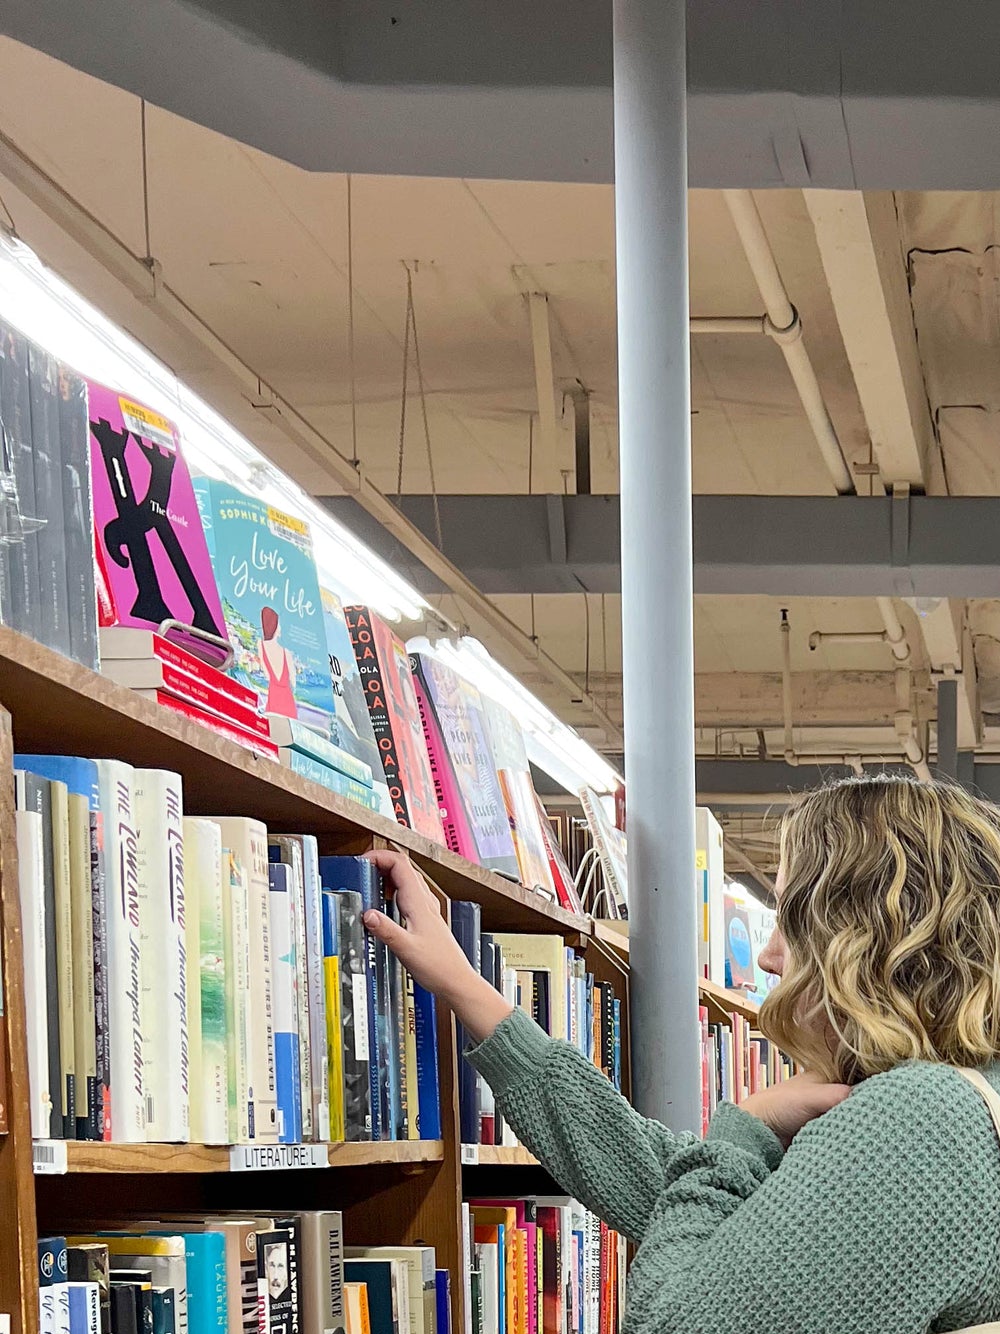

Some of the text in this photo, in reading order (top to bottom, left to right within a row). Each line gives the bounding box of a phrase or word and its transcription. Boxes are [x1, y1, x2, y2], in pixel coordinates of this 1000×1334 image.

[150, 500, 166, 516] The
[252, 531, 288, 574] Love
[284, 579, 316, 618] Life
[416, 696, 444, 802] PEOPLE LIKE HER
[166, 787, 181, 826] THE
[168, 828, 188, 931] LOWLAND
[117, 780, 145, 1097] THE LOWLAND Jhumpa Lahiri
[174, 932, 188, 1029] Jhumpa
[245, 1145, 317, 1168] LITERATURE: L
[42, 1294, 54, 1320] We
[215, 1263, 224, 1326] LAUREN
